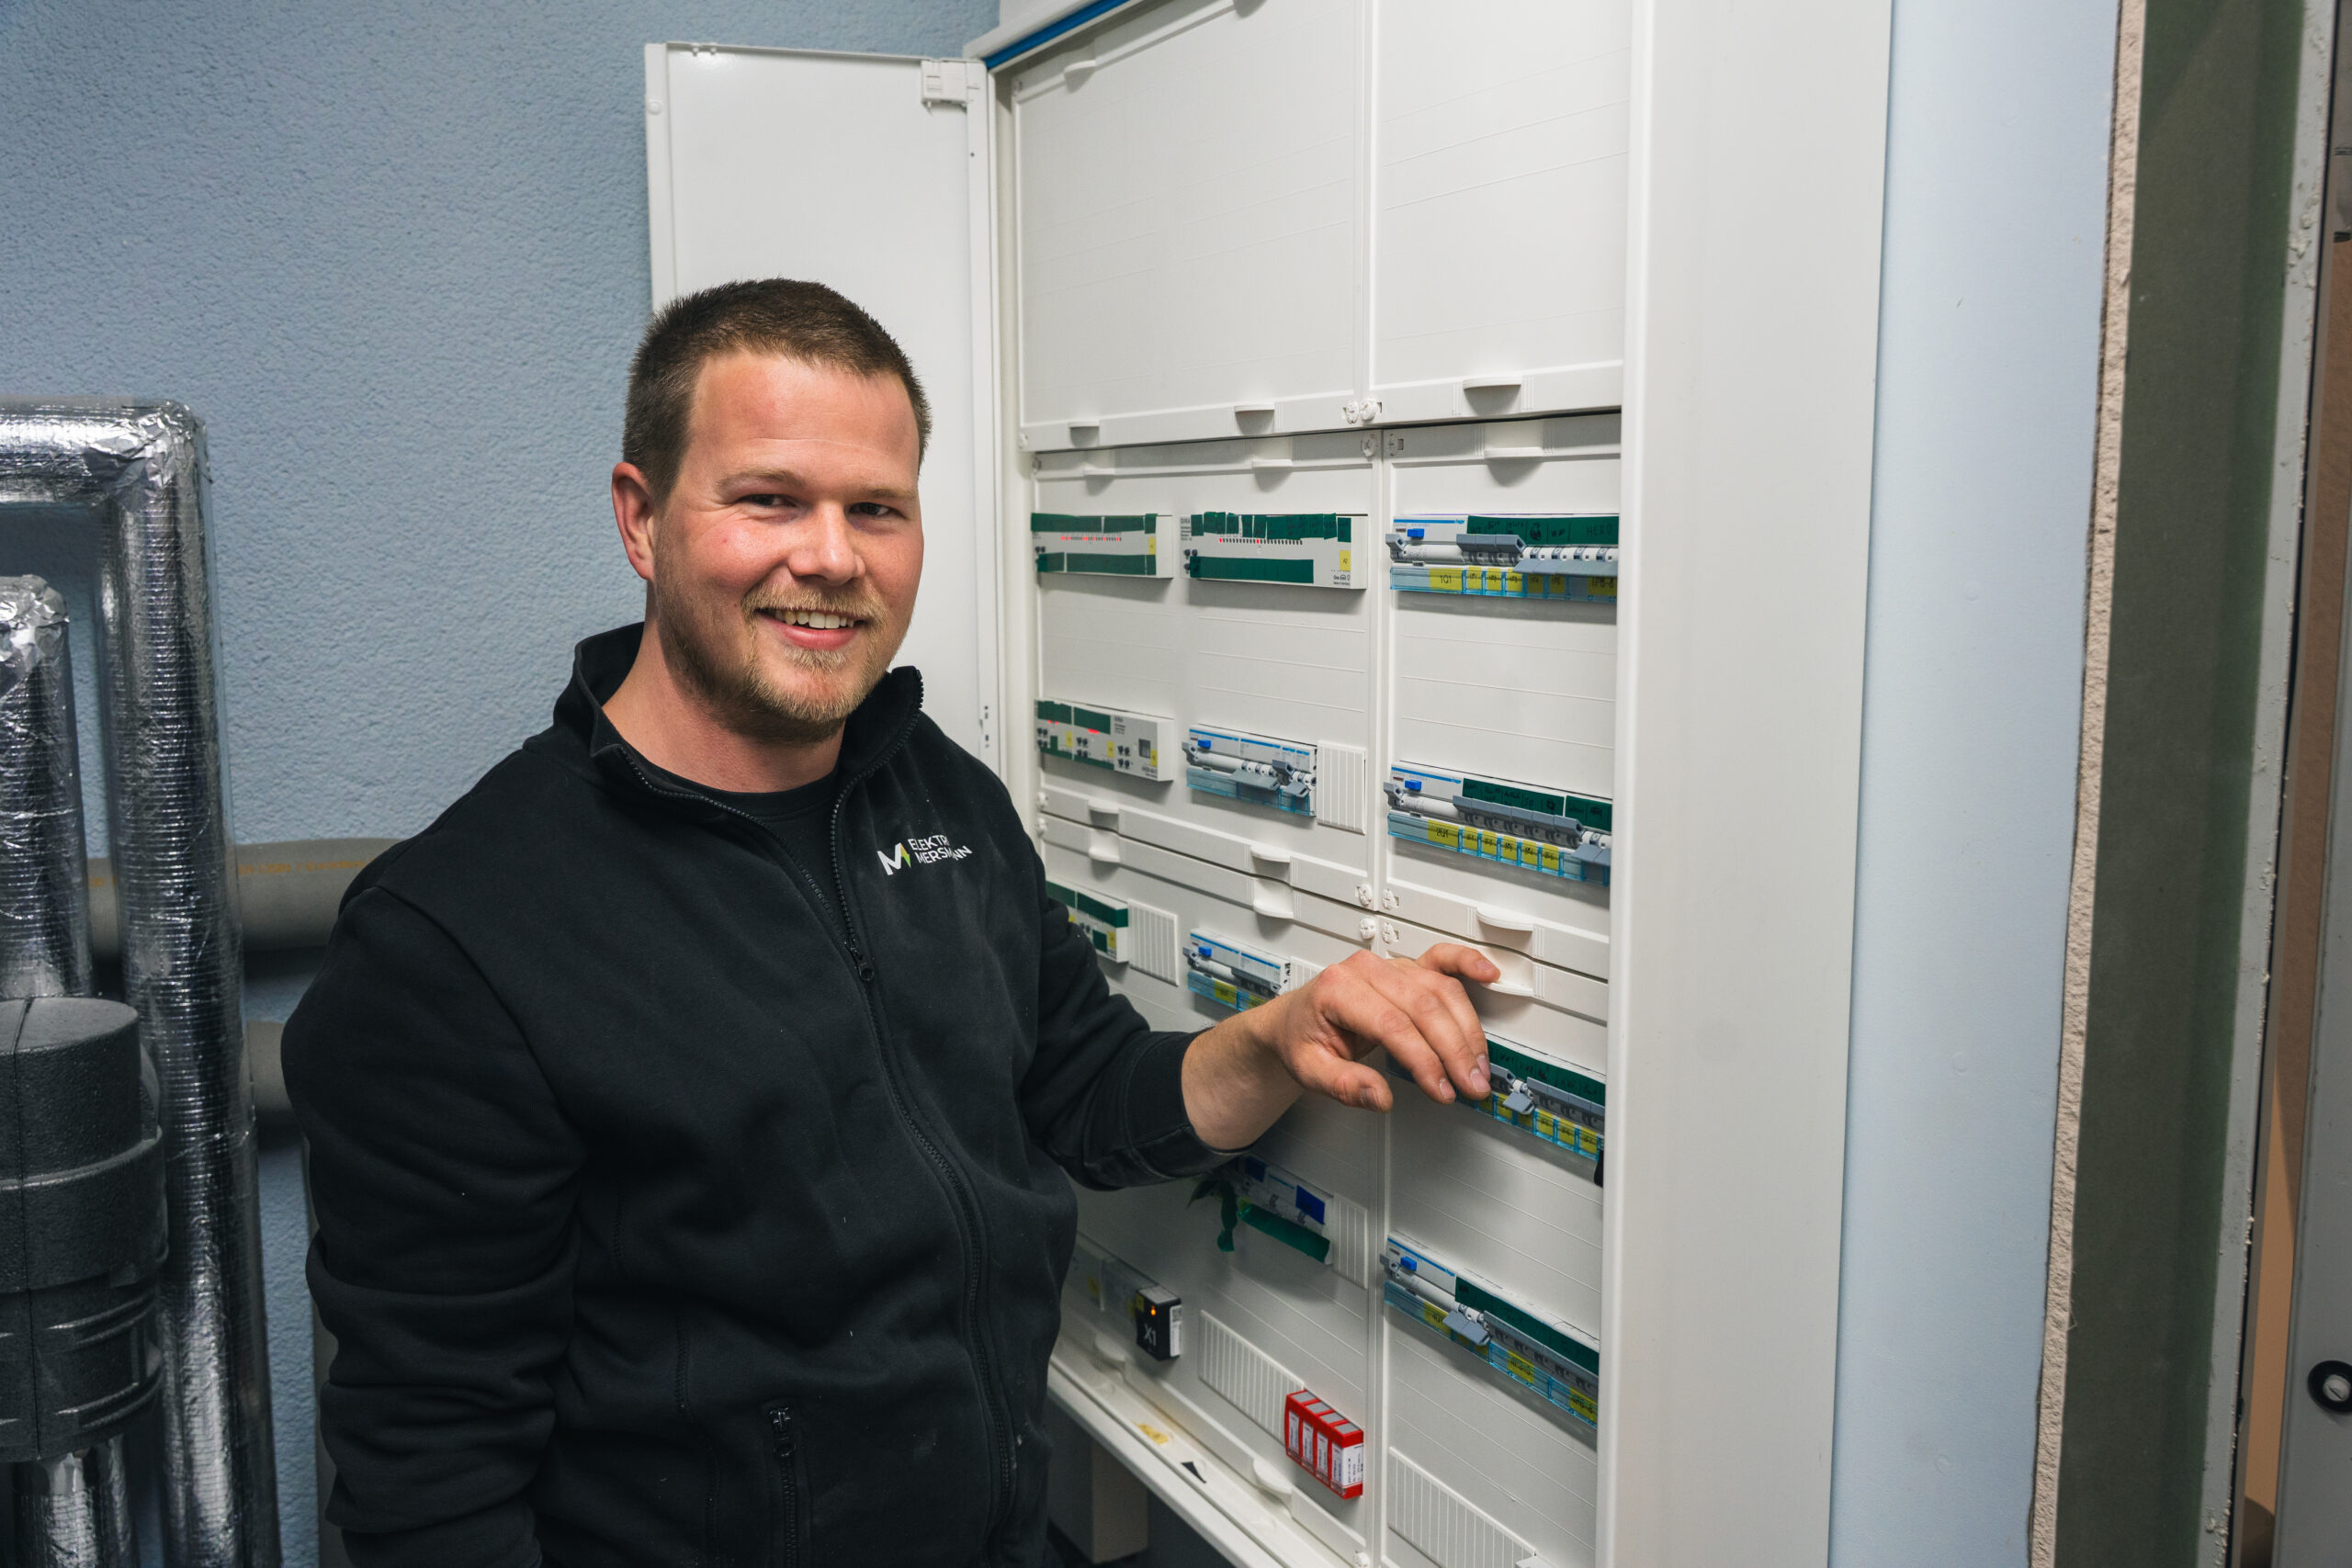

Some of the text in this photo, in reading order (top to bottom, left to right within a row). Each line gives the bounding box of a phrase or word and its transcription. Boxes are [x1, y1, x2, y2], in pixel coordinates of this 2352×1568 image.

[1440, 574, 1453, 584] 1Q1
[907, 834, 950, 851] ELEKTR
[914, 845, 973, 863] MERSMNN
[1143, 1323, 1157, 1347] X1
